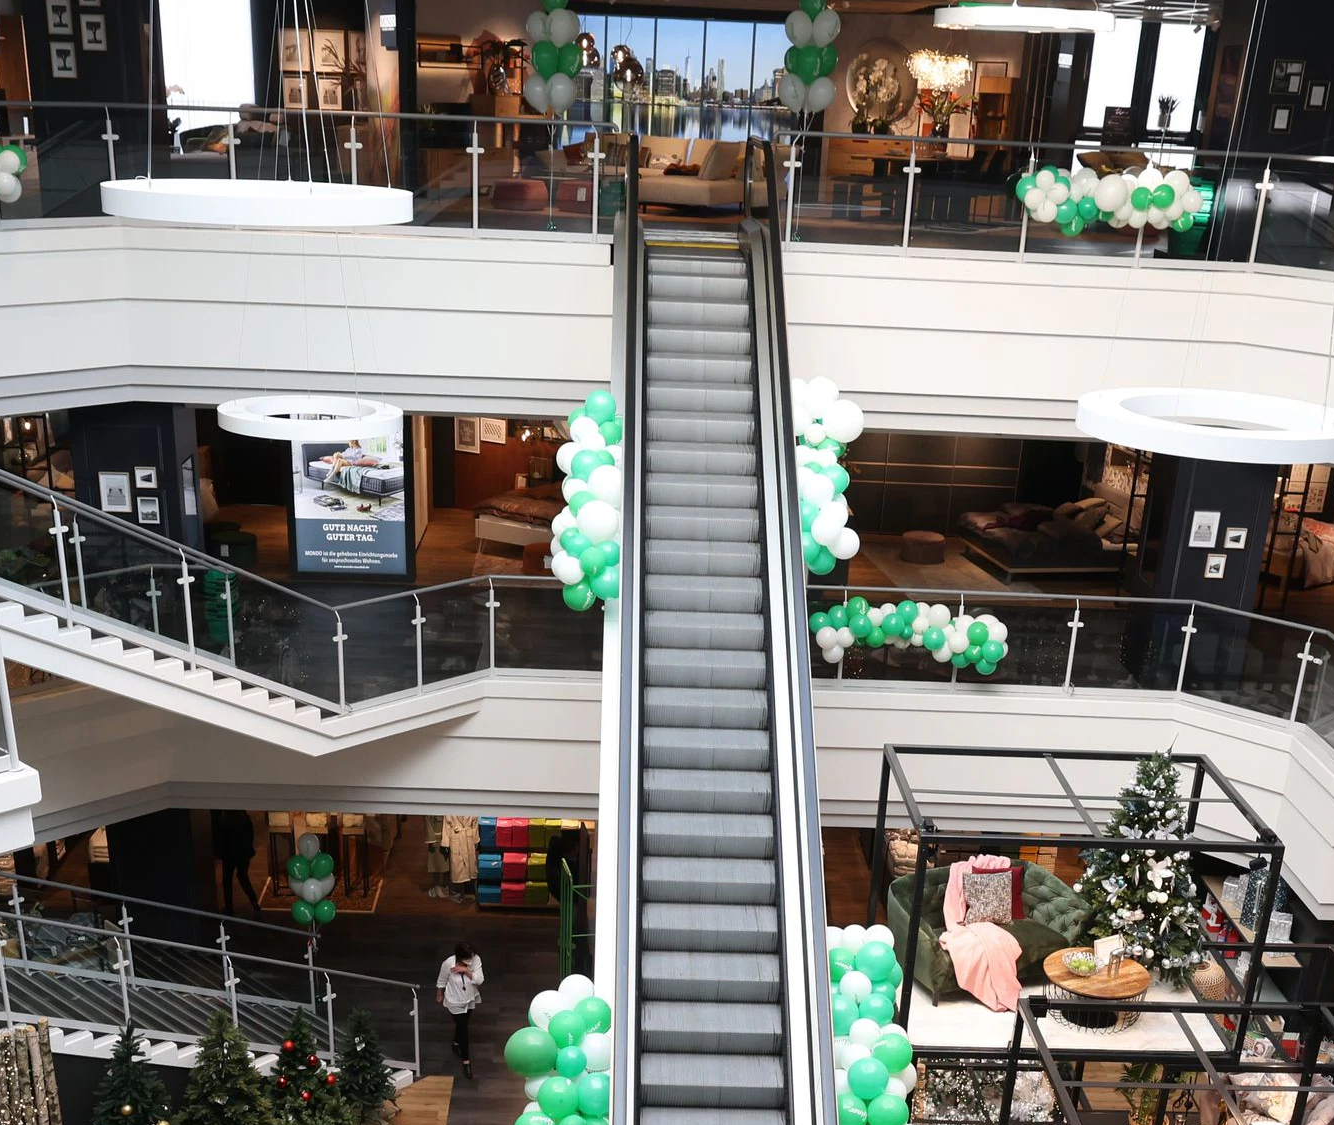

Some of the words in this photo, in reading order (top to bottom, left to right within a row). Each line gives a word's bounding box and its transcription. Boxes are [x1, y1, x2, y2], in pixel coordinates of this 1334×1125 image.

[322, 523, 346, 532] GUTE
[346, 524, 379, 534] NACHT,
[326, 533, 355, 541] GUTER
[355, 534, 376, 542] TAG.
